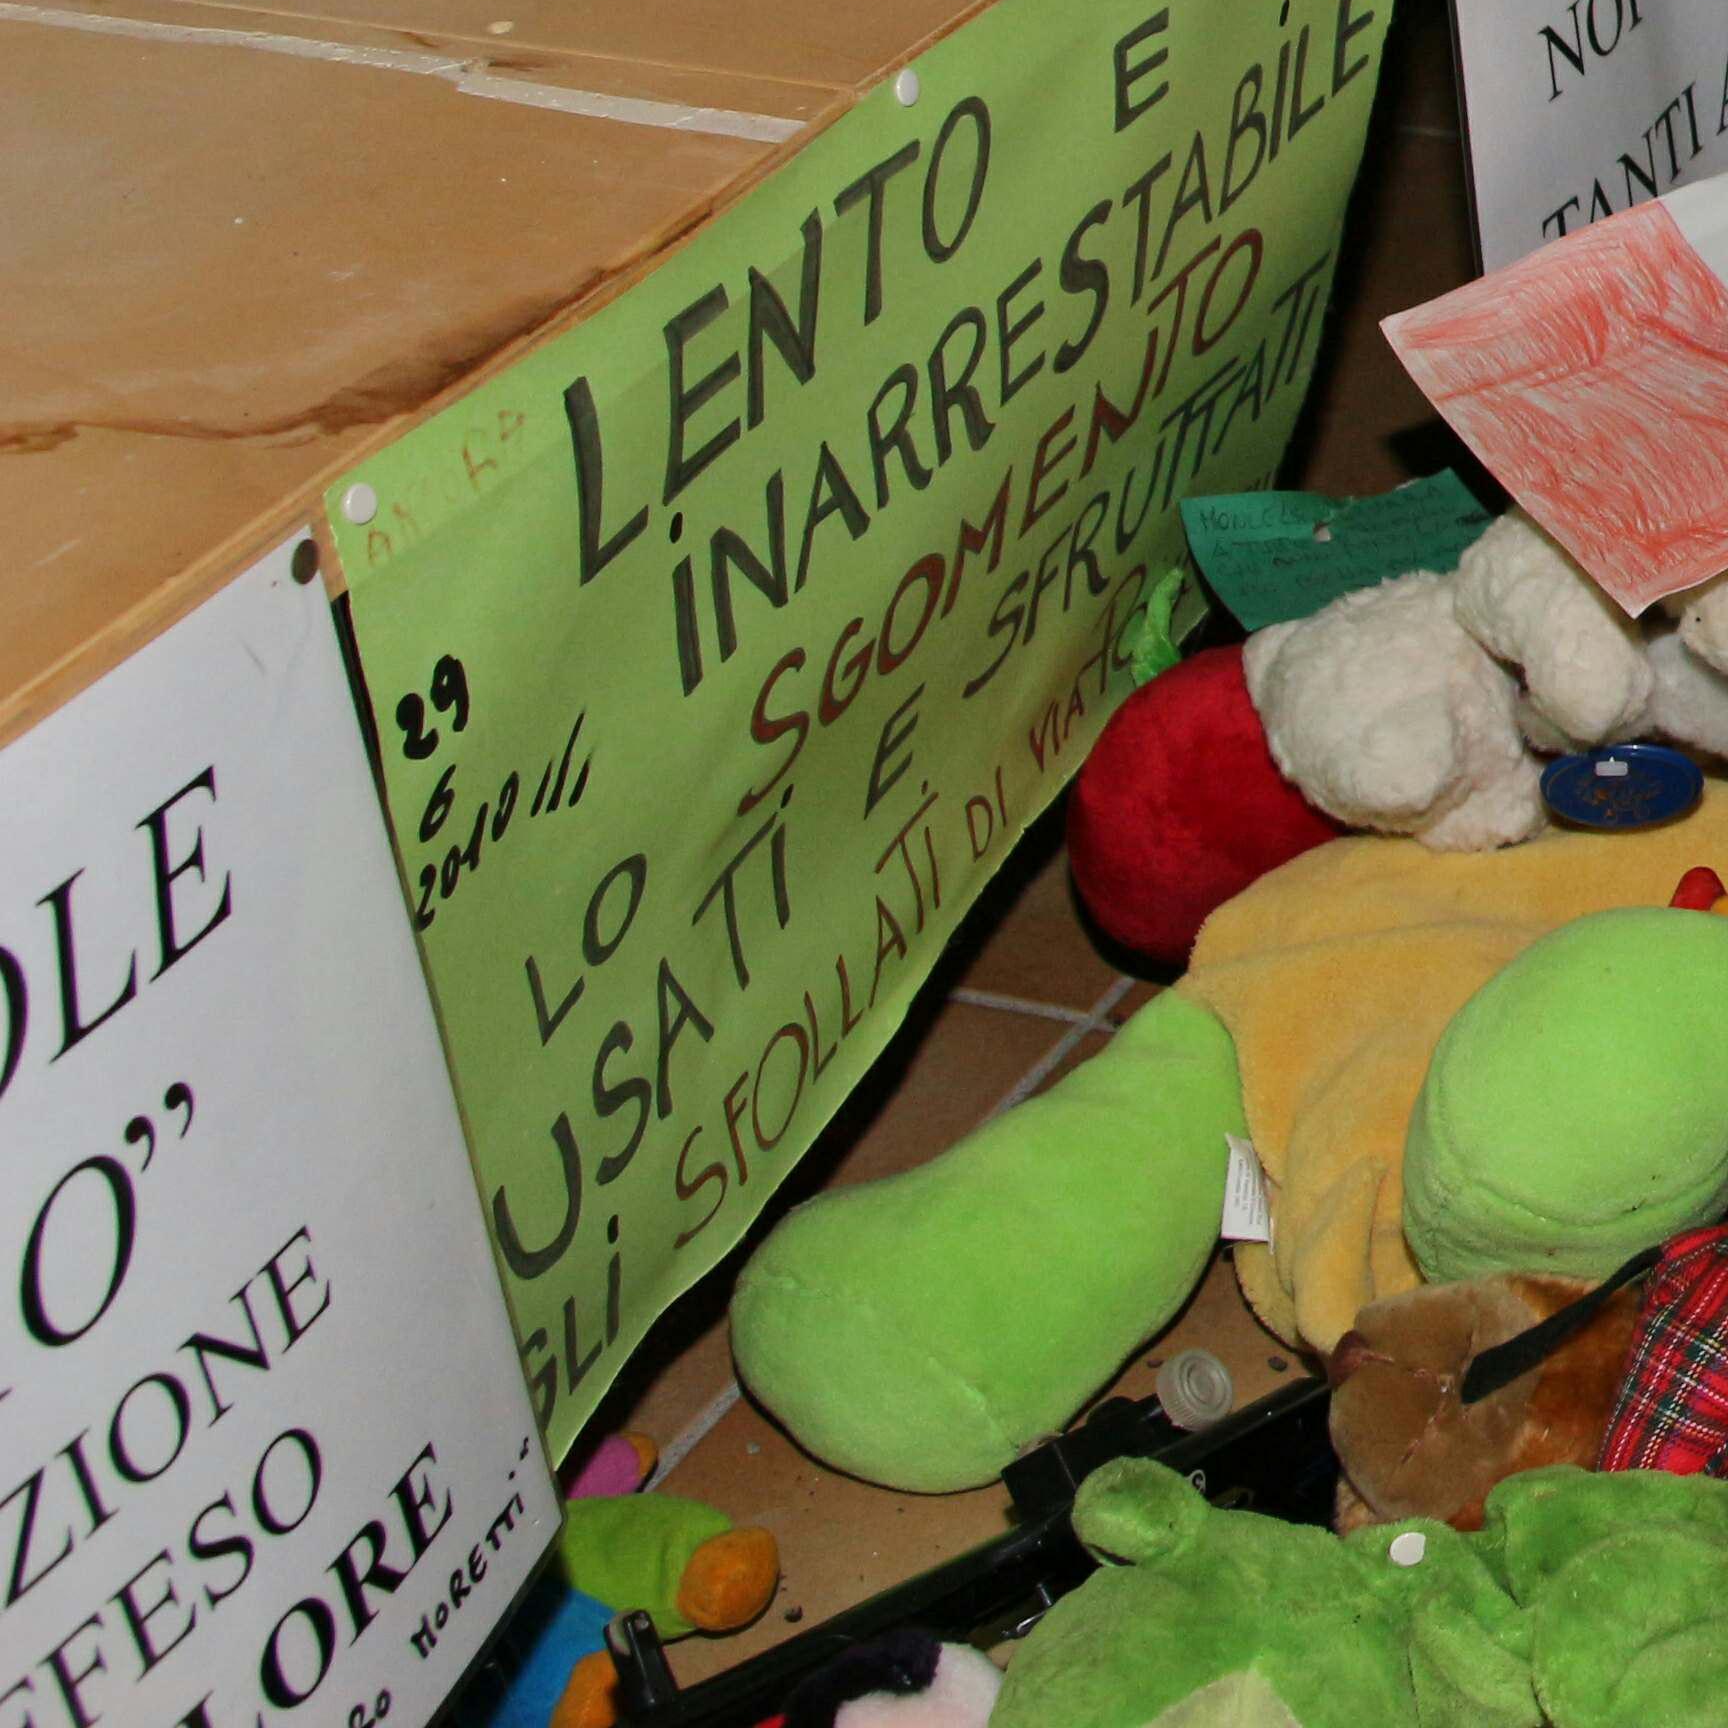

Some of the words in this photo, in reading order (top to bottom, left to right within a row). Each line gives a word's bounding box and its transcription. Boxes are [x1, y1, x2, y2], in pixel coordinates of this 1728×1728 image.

[564, 96, 991, 586] LENTO
[1114, 7, 1170, 134] E
[396, 654, 469, 760] 29
[419, 764, 456, 843] 6
[492, 783, 794, 1281] USATI
[864, 684, 926, 820] E
[962, 248, 1331, 700] SFRUTTATI
[524, 852, 647, 1046] LO
[737, 227, 1264, 817] SGOMENTO
[0, 765, 231, 1098] LE
[675, 779, 941, 1250] SFOLLATI
[964, 765, 1006, 862] DI
[1029, 699, 1085, 773] VIA
